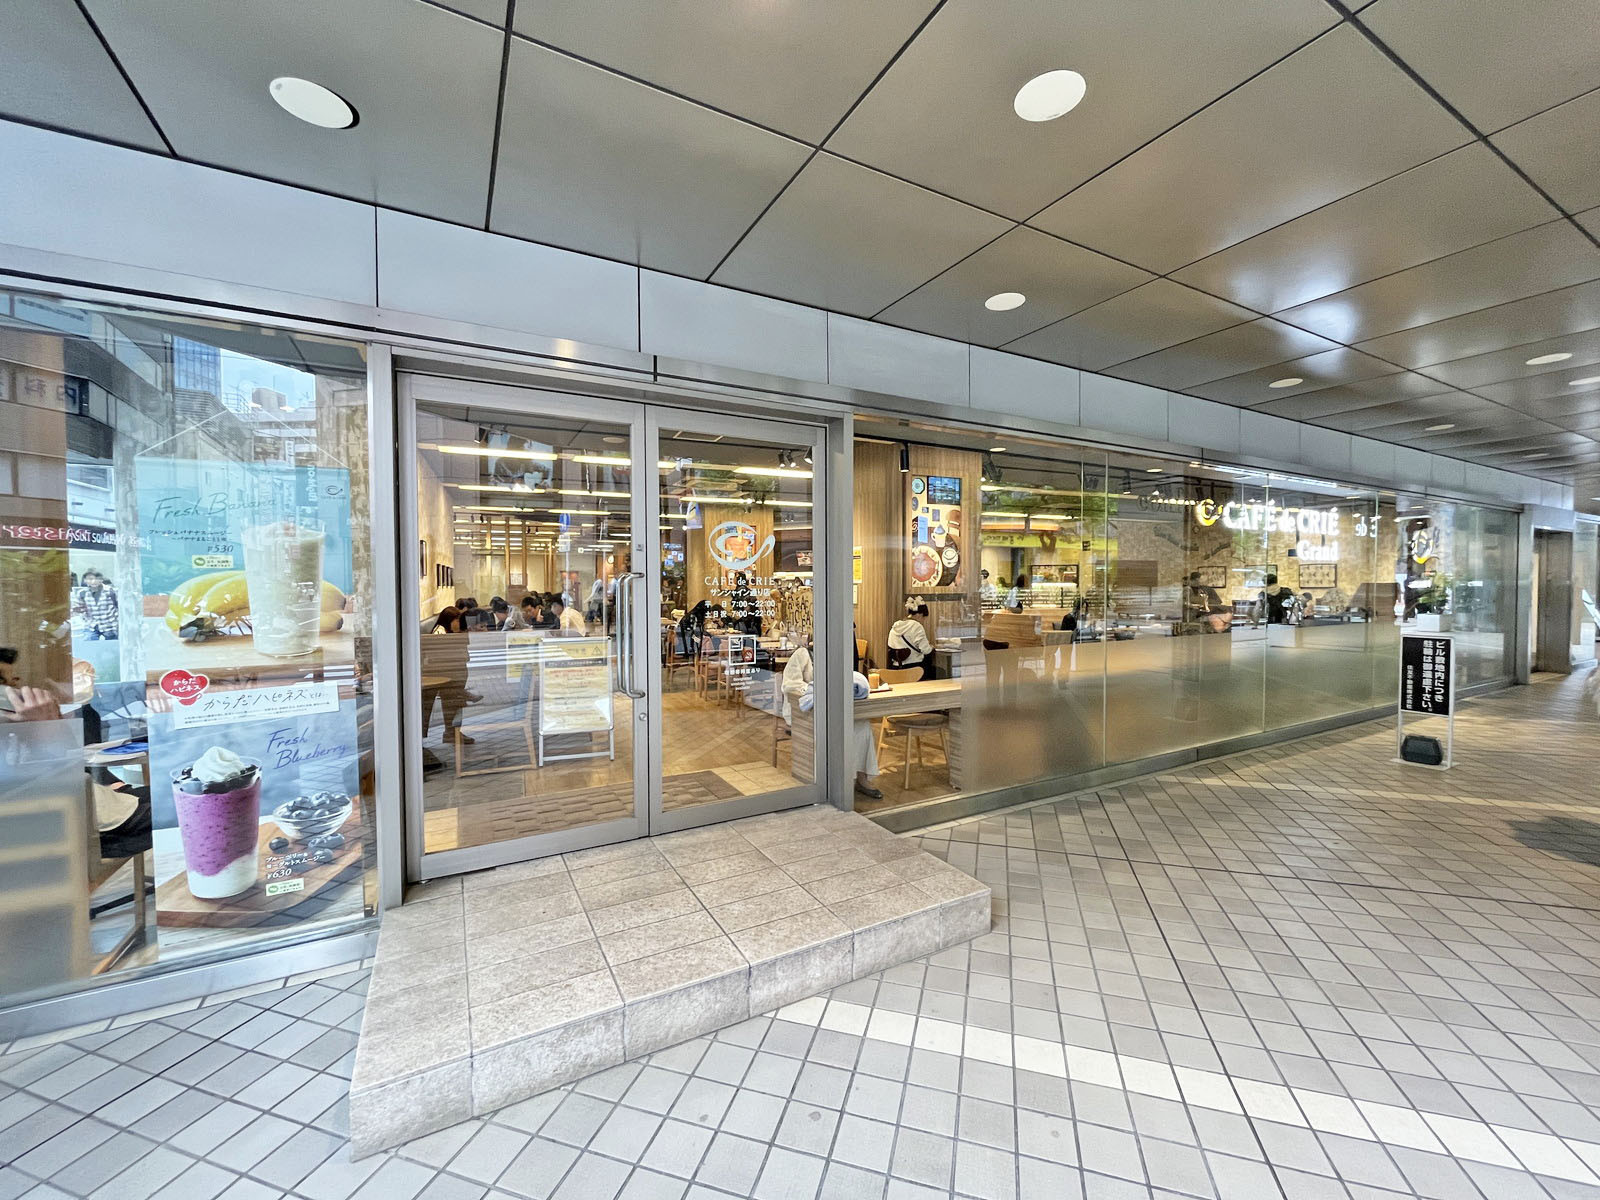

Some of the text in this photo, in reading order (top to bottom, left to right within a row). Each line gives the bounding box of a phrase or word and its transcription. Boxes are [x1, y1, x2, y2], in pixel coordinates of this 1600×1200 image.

[152, 495, 202, 523] Fresh
[1278, 508, 1297, 533] de
[1297, 540, 1341, 561] Grand
[710, 588, 771, 597] サンシャイン通り店
[737, 576, 747, 586] de
[173, 677, 197, 687] からだ
[1434, 641, 1446, 703] ビル敷地内につき
[266, 727, 309, 753] Fresh
[273, 743, 350, 770] Blueberry
[267, 868, 292, 879] ¥630
